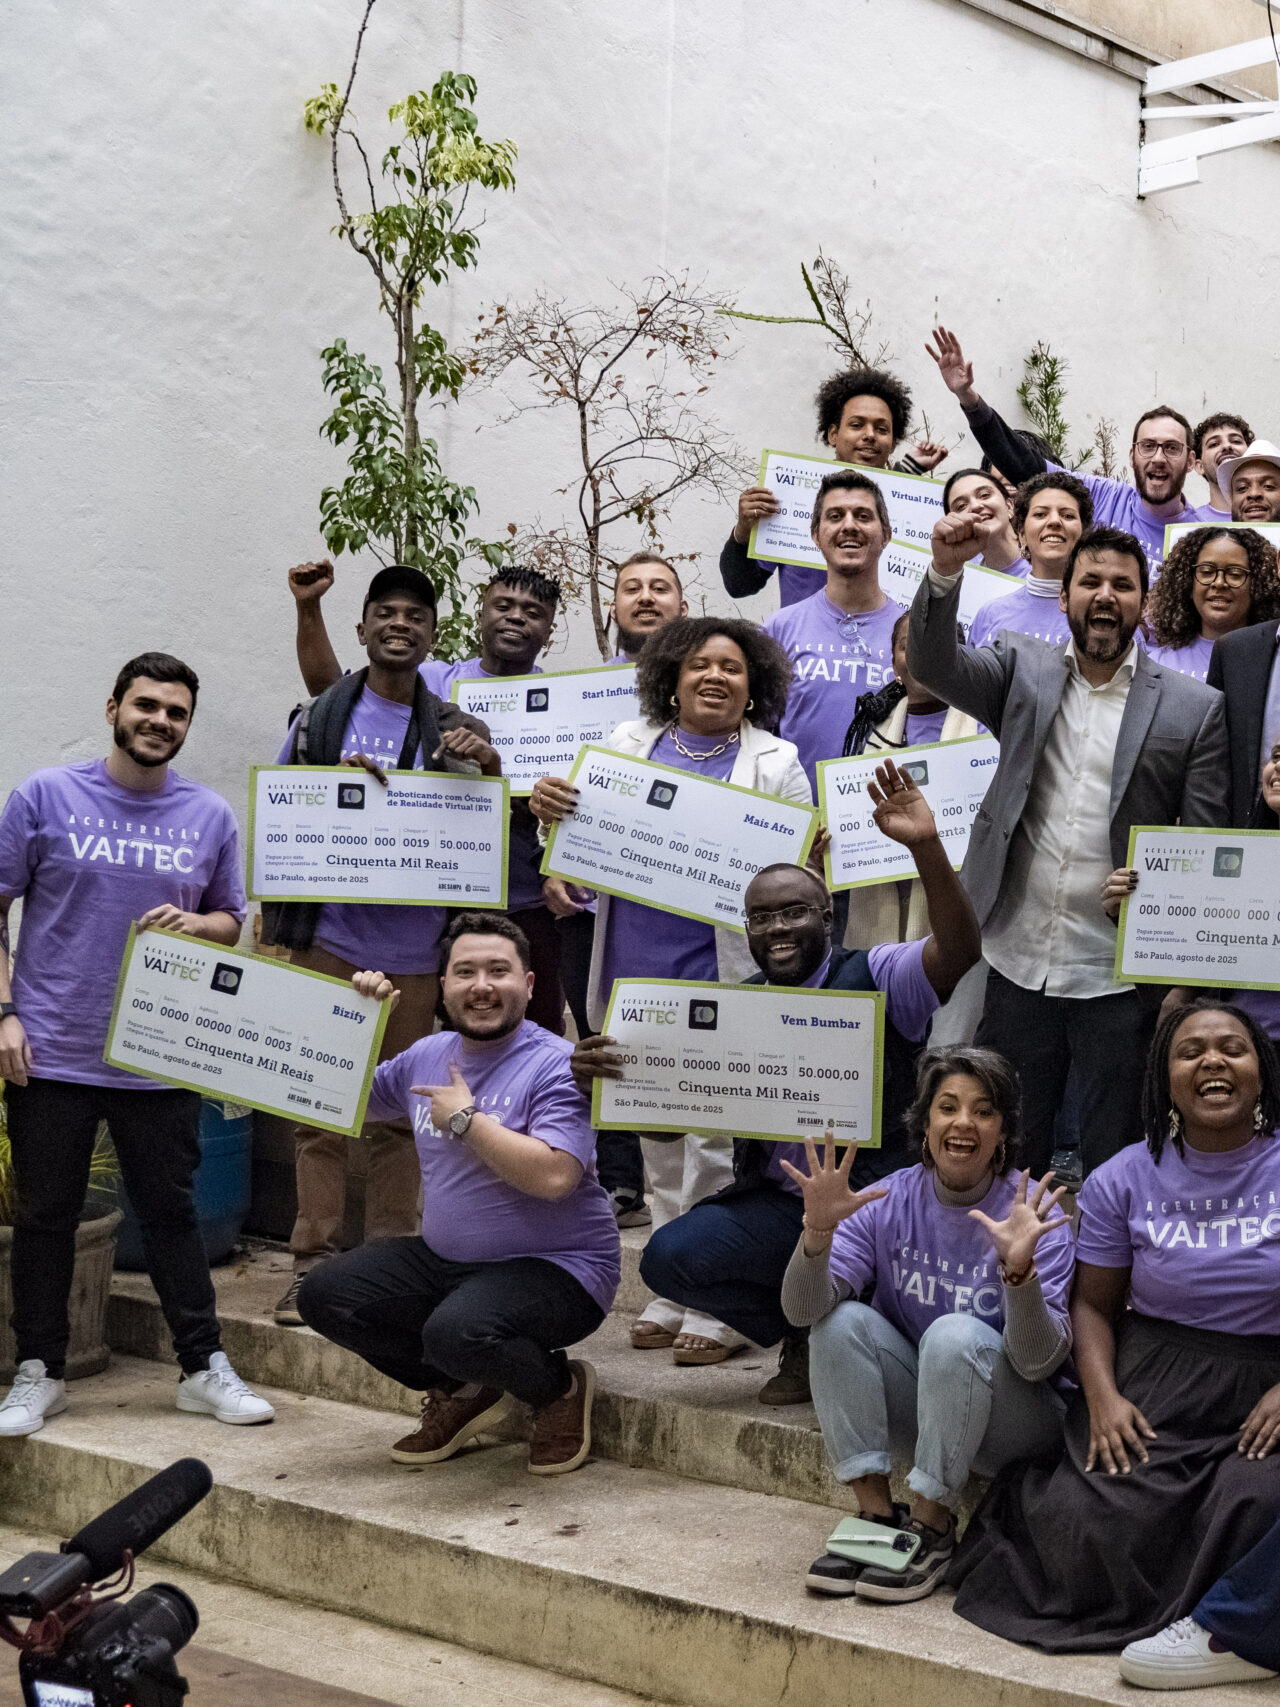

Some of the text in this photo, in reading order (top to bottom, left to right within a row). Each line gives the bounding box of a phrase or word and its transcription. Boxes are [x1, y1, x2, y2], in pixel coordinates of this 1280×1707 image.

[891, 490, 921, 504] Virtual
[582, 691, 604, 699] Start
[468, 701, 516, 713] VAITEC
[580, 732, 603, 741] 0022
[514, 753, 574, 764] Cinquenta
[588, 773, 640, 797] VAITEC
[268, 792, 325, 805] VAITEC
[387, 790, 443, 801] Roboticando
[464, 794, 492, 803] Óculos
[401, 799, 443, 809] Realidade
[445, 802, 472, 810] Virtual
[475, 803, 492, 812] (RV)
[69, 815, 200, 840] ACELERAÇÃO
[743, 814, 795, 836] Mais Afro
[403, 838, 491, 852] 0019 50.000,00
[68, 833, 196, 874] VAITEC
[694, 848, 719, 863] 0015
[326, 854, 459, 870] Cinquenta Mil Reais
[620, 848, 741, 892] Cinquenta Mil Reais
[1145, 858, 1200, 873] VAITEC
[1140, 904, 1160, 914] 000
[1168, 906, 1196, 916] 0000
[1204, 908, 1240, 919] 00000
[1248, 910, 1270, 920] 000
[1196, 930, 1268, 947] Cinquenta
[144, 956, 201, 982] VAITEC
[332, 1005, 366, 1025] Bizify
[621, 1008, 676, 1024] VAITEC
[781, 1014, 860, 1030] Vem Bumbar
[185, 1036, 314, 1083] Cinquenta Mil Reais
[265, 1036, 354, 1071] 0003 50.000,00
[646, 1056, 859, 1081] 0000 00000 000 0023 50.000,00
[678, 1080, 820, 1102] Cinquenta Mil Reais
